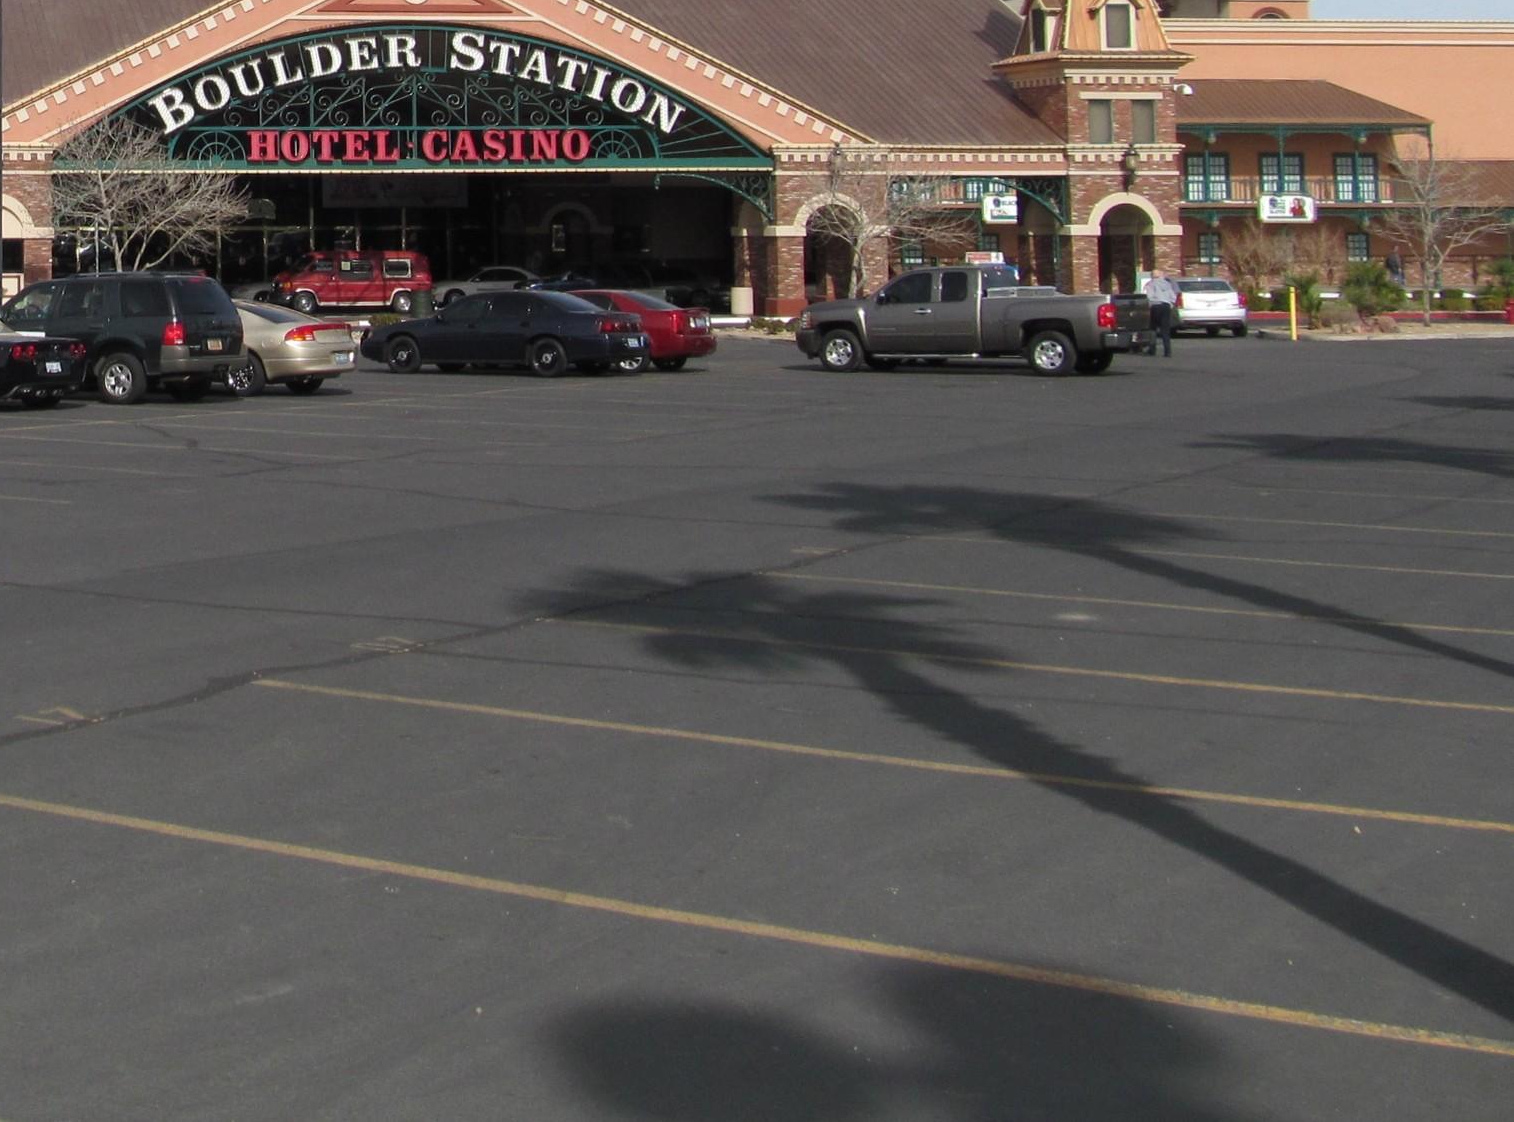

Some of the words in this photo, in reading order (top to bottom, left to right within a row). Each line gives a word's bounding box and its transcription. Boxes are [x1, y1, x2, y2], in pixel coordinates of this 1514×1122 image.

[148, 35, 421, 134] BOULDER
[450, 32, 685, 134] STATION
[246, 130, 399, 162] HOTEL
[421, 130, 591, 162] CASINO
